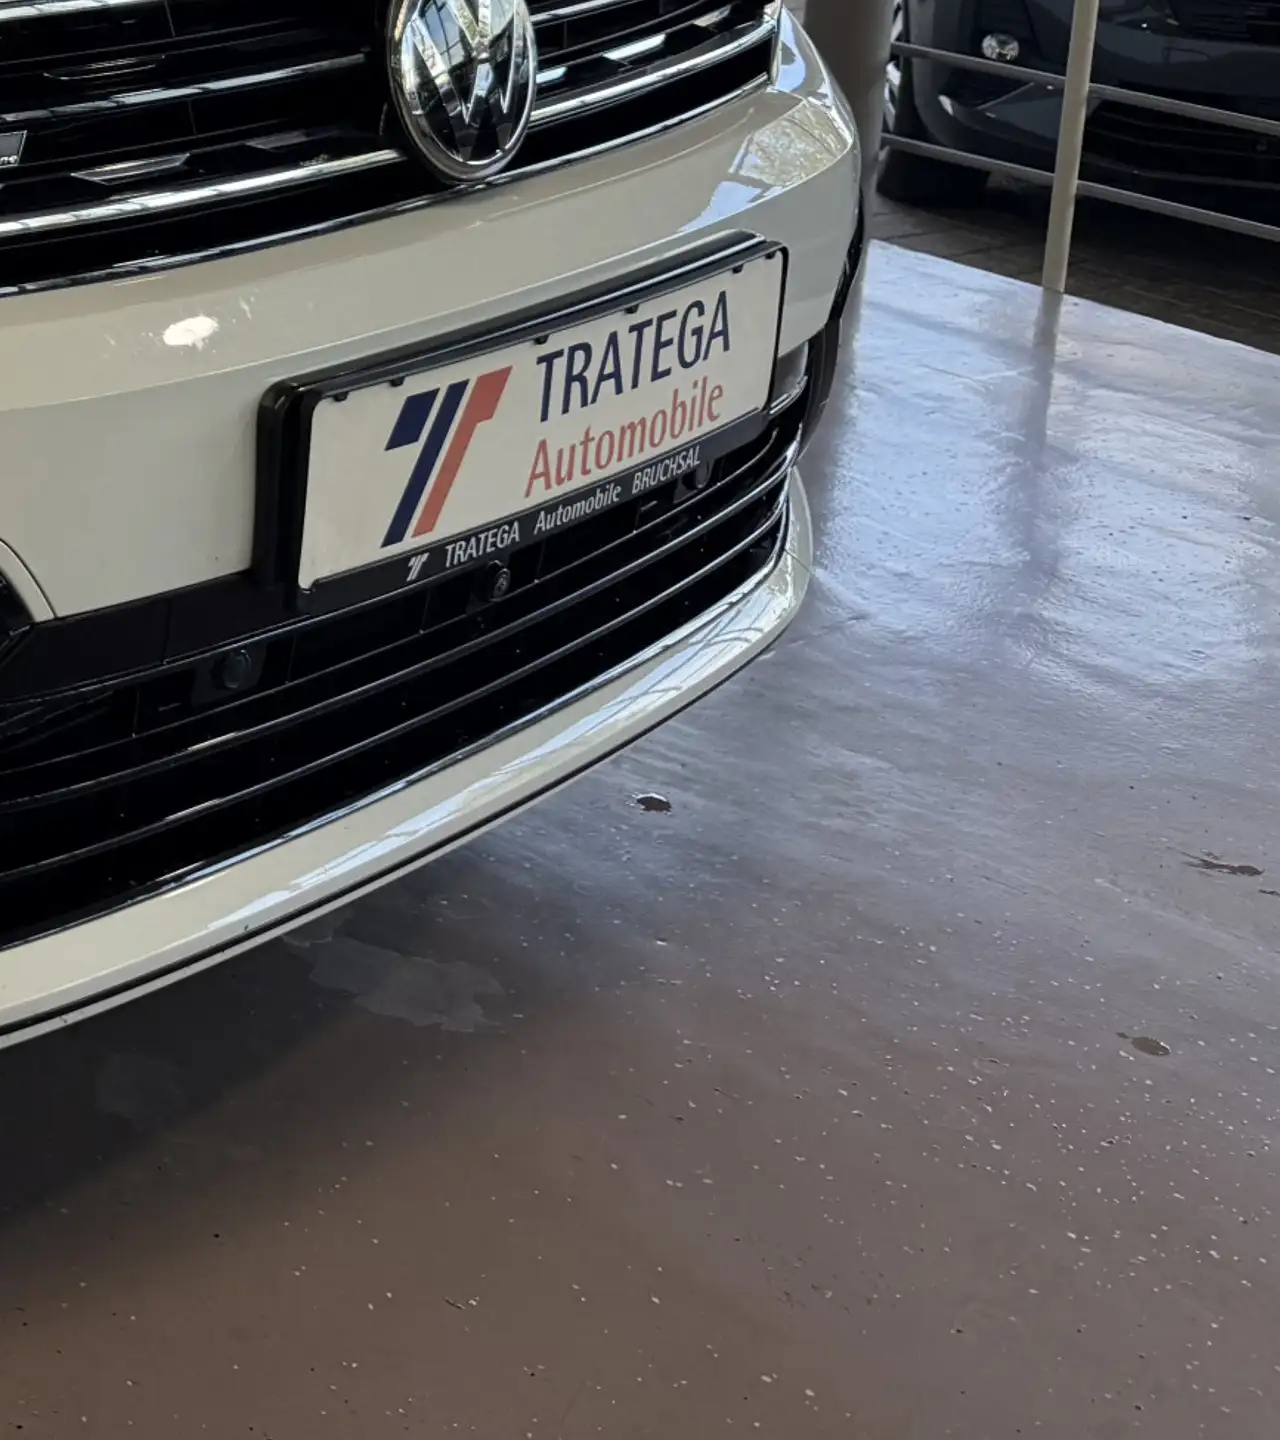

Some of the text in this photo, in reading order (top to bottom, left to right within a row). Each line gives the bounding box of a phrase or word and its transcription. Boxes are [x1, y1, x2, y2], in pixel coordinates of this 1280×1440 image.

[536, 290, 730, 423] TRATEGA
[524, 375, 724, 498] Automobile
[445, 445, 701, 568] TRATEGA Automobile BRUCHSAL
